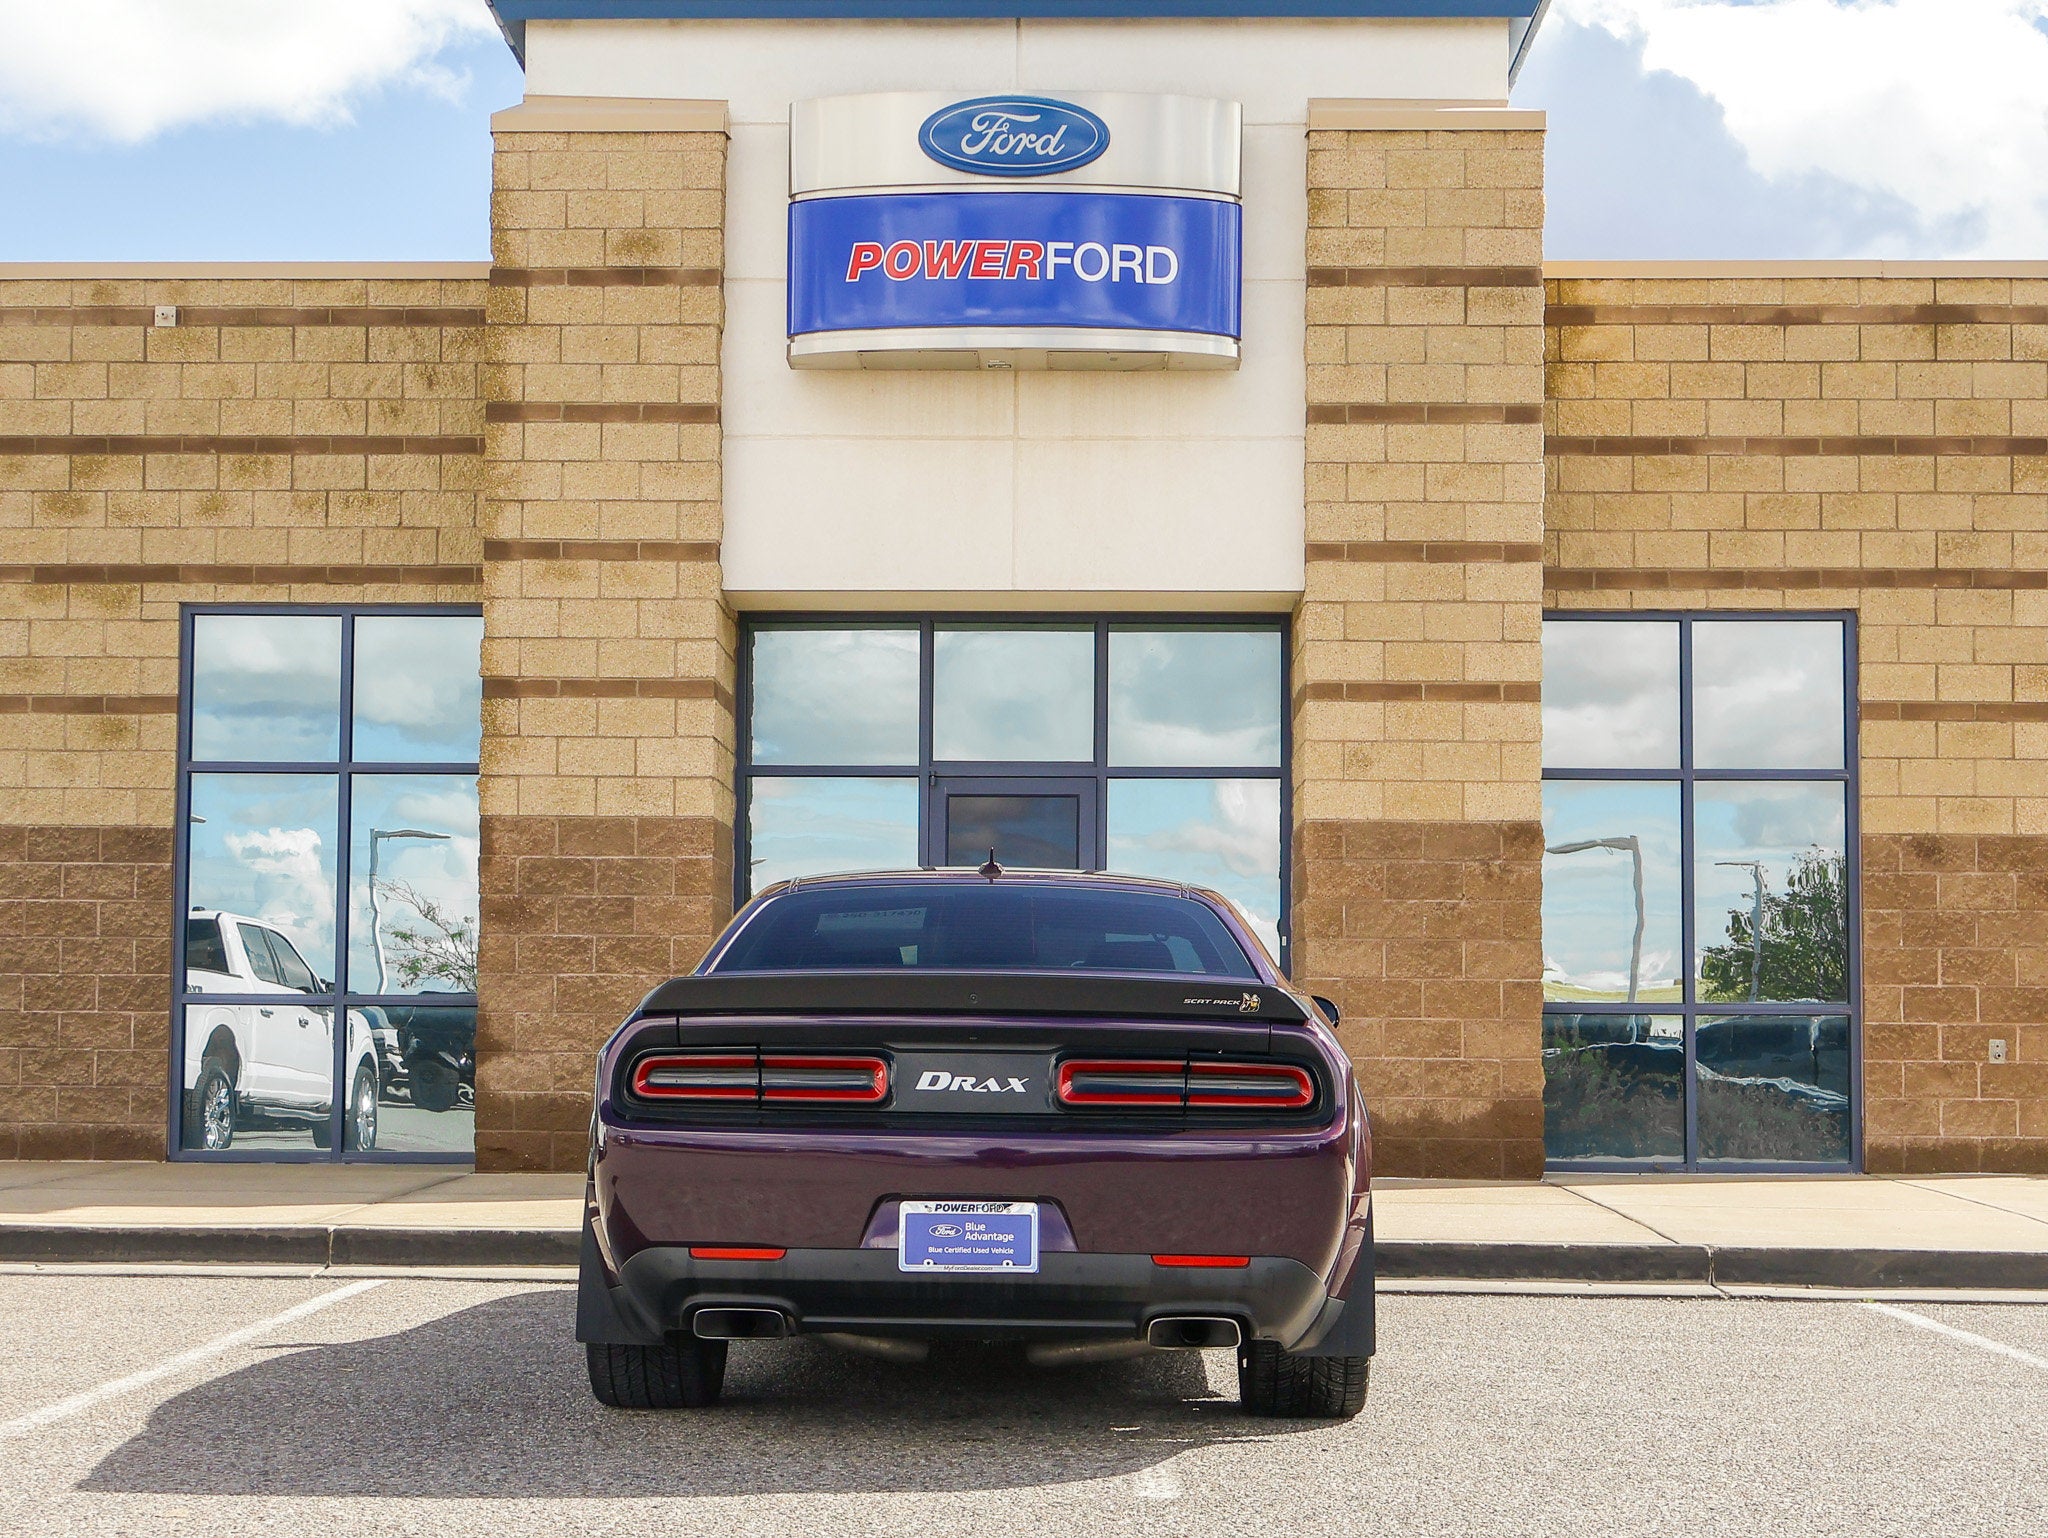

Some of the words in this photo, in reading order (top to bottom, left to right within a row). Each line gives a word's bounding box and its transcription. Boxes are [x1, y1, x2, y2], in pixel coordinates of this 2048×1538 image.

[960, 110, 1068, 157] Ford
[845, 239, 1179, 285] POWERFORD
[915, 1070, 1030, 1093] DRAX
[935, 1225, 956, 1235] Ford
[965, 1222, 986, 1231] Blue
[964, 1232, 1015, 1243] Advantage
[944, 1246, 972, 1254] Certified
